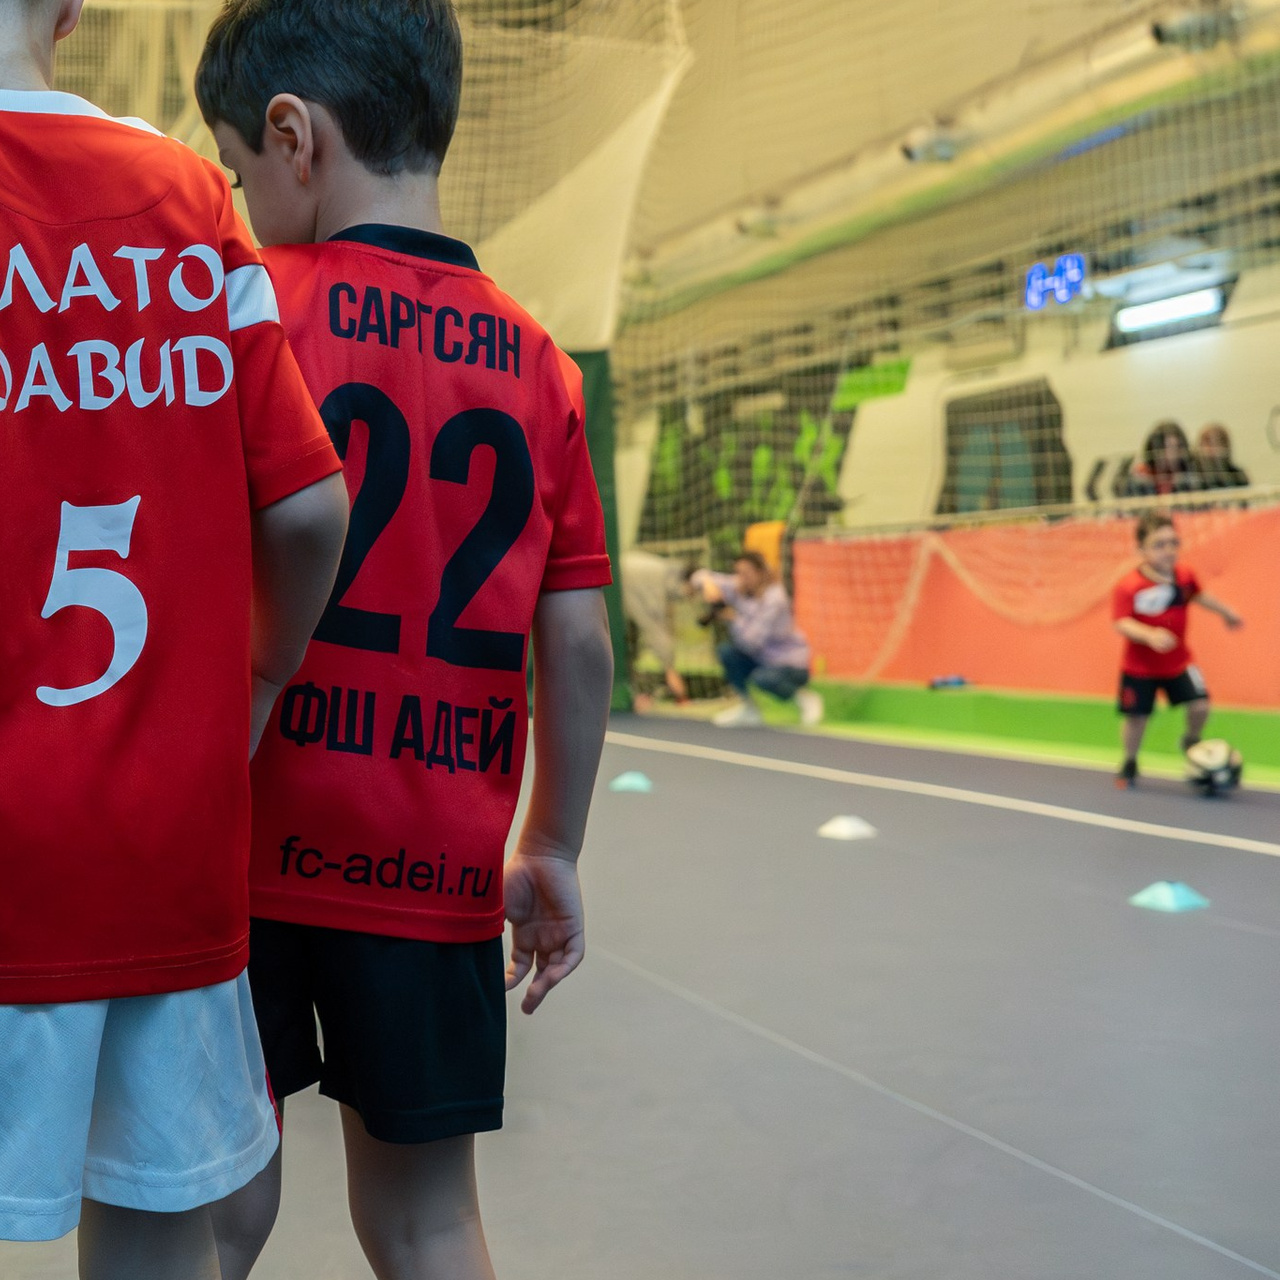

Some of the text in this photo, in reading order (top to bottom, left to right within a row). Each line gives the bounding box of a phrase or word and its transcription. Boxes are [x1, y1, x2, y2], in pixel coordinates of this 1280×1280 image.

[328, 281, 521, 380] САРГСЯН
[311, 381, 536, 672] 22
[35, 494, 149, 707] 5
[279, 680, 517, 775] ФШ АДЕЙ
[279, 835, 493, 898] fc-adei.ru
